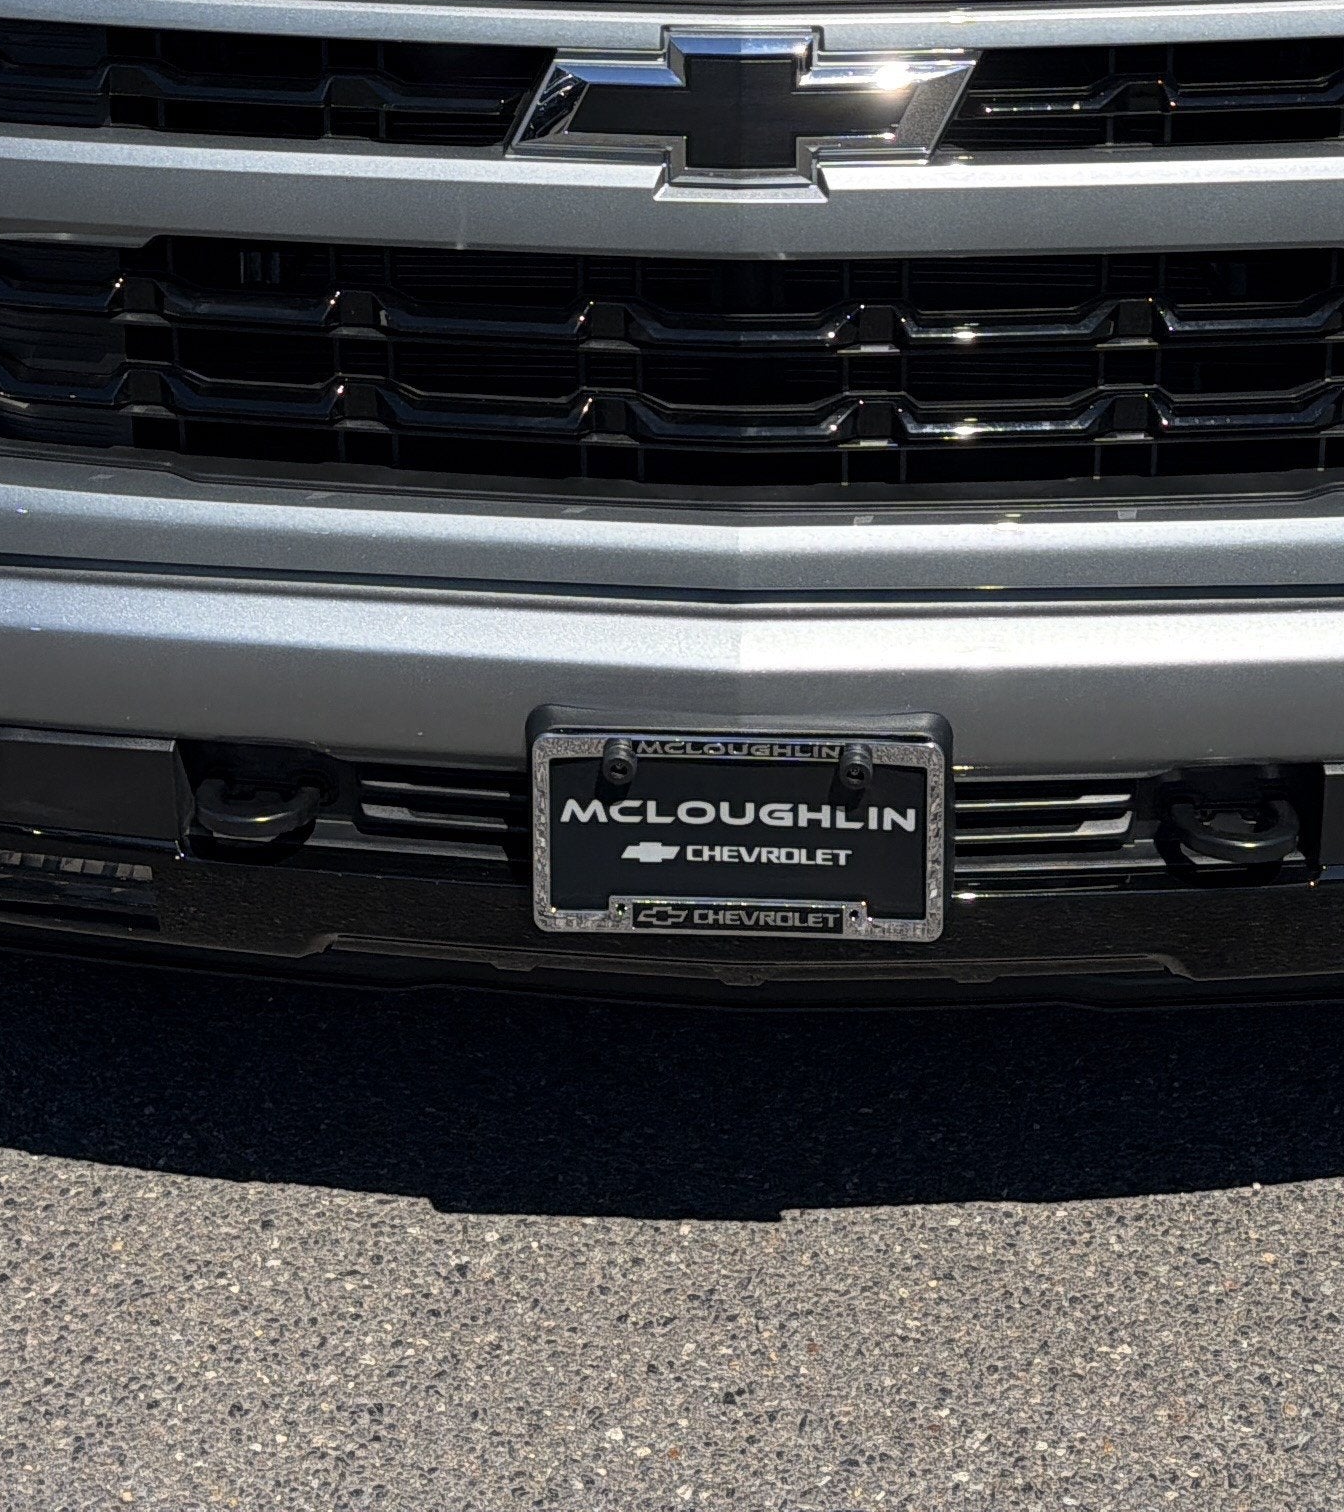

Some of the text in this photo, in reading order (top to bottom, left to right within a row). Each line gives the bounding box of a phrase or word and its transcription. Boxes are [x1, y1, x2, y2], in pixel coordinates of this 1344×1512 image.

[636, 740, 842, 759] MCLOUGHLIN
[560, 798, 916, 832] MCLOUGHLIN
[686, 844, 853, 866] CHEVROLET
[692, 908, 841, 929] CHEVROLET
